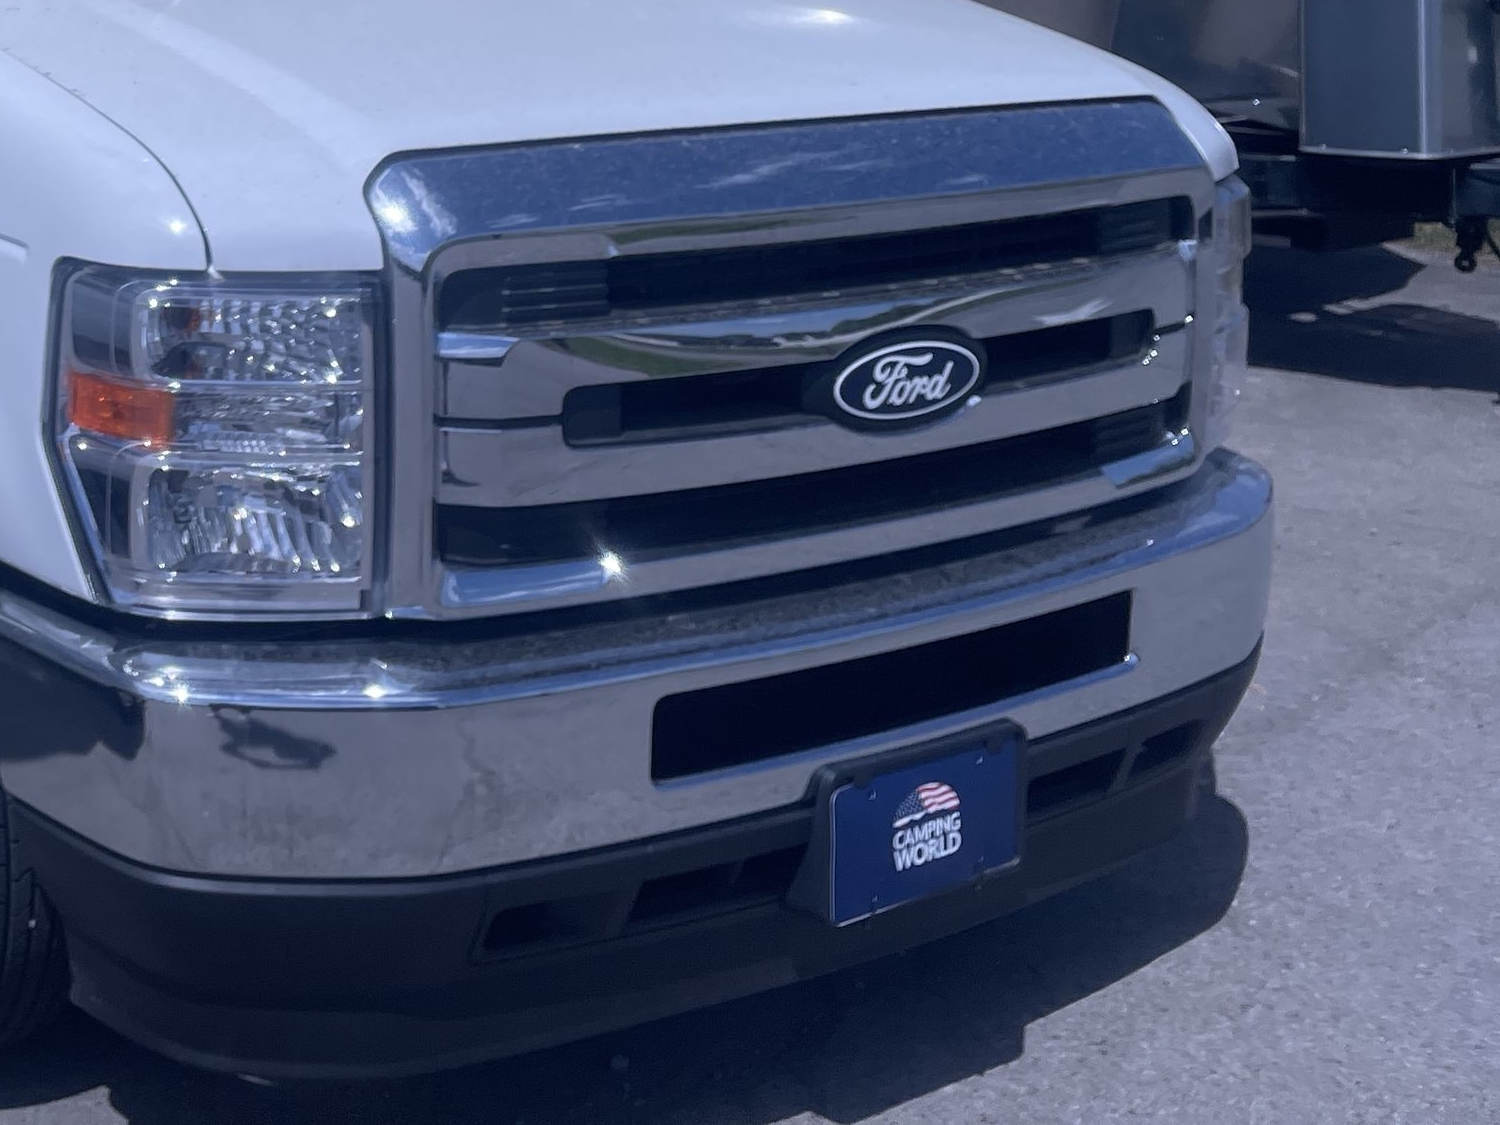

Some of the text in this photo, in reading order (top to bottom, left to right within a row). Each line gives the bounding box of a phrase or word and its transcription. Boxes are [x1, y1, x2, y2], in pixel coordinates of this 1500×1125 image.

[862, 351, 955, 410] Ford
[891, 810, 962, 851] CAMPING
[893, 830, 963, 872] WORLD
